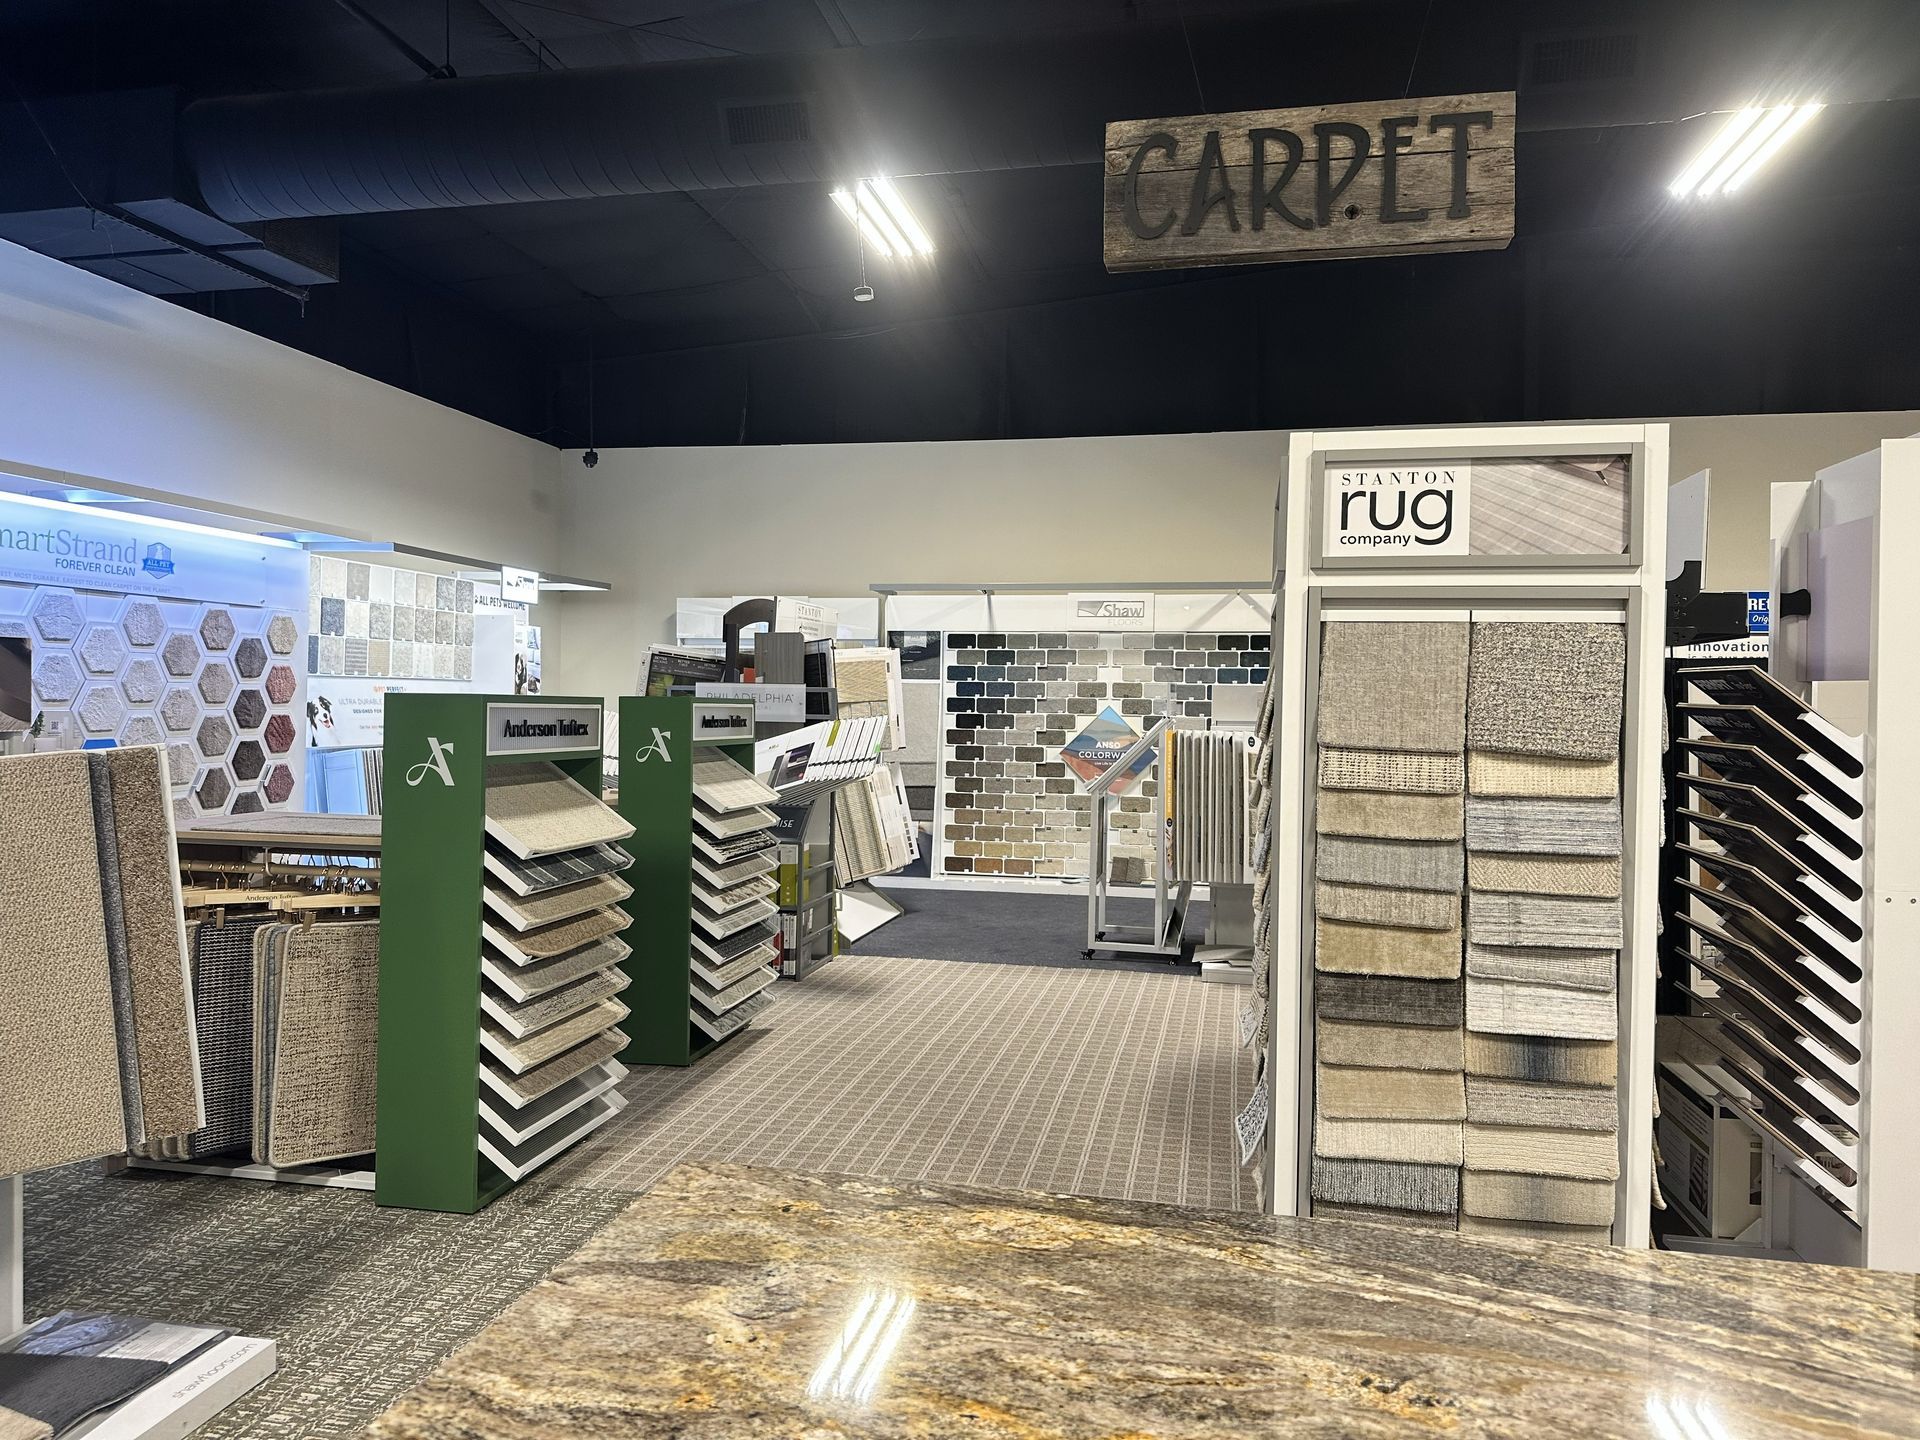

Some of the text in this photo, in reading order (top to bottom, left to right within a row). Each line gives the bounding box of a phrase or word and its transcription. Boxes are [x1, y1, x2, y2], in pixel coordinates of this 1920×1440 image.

[1126, 110, 1493, 240] CARPET
[1341, 470, 1457, 486] STANTON
[1340, 489, 1454, 546] rug
[1340, 533, 1412, 547] company
[55, 557, 101, 573] FOREVER
[104, 564, 136, 577] CLEAN
[479, 595, 489, 606] ALL
[489, 597, 502, 608] PETS
[1103, 604, 1143, 617] Shaw
[503, 718, 589, 738] Anderson Tuftex
[701, 714, 747, 729] Anderson Tuftex
[1095, 741, 1121, 749] ANSO
